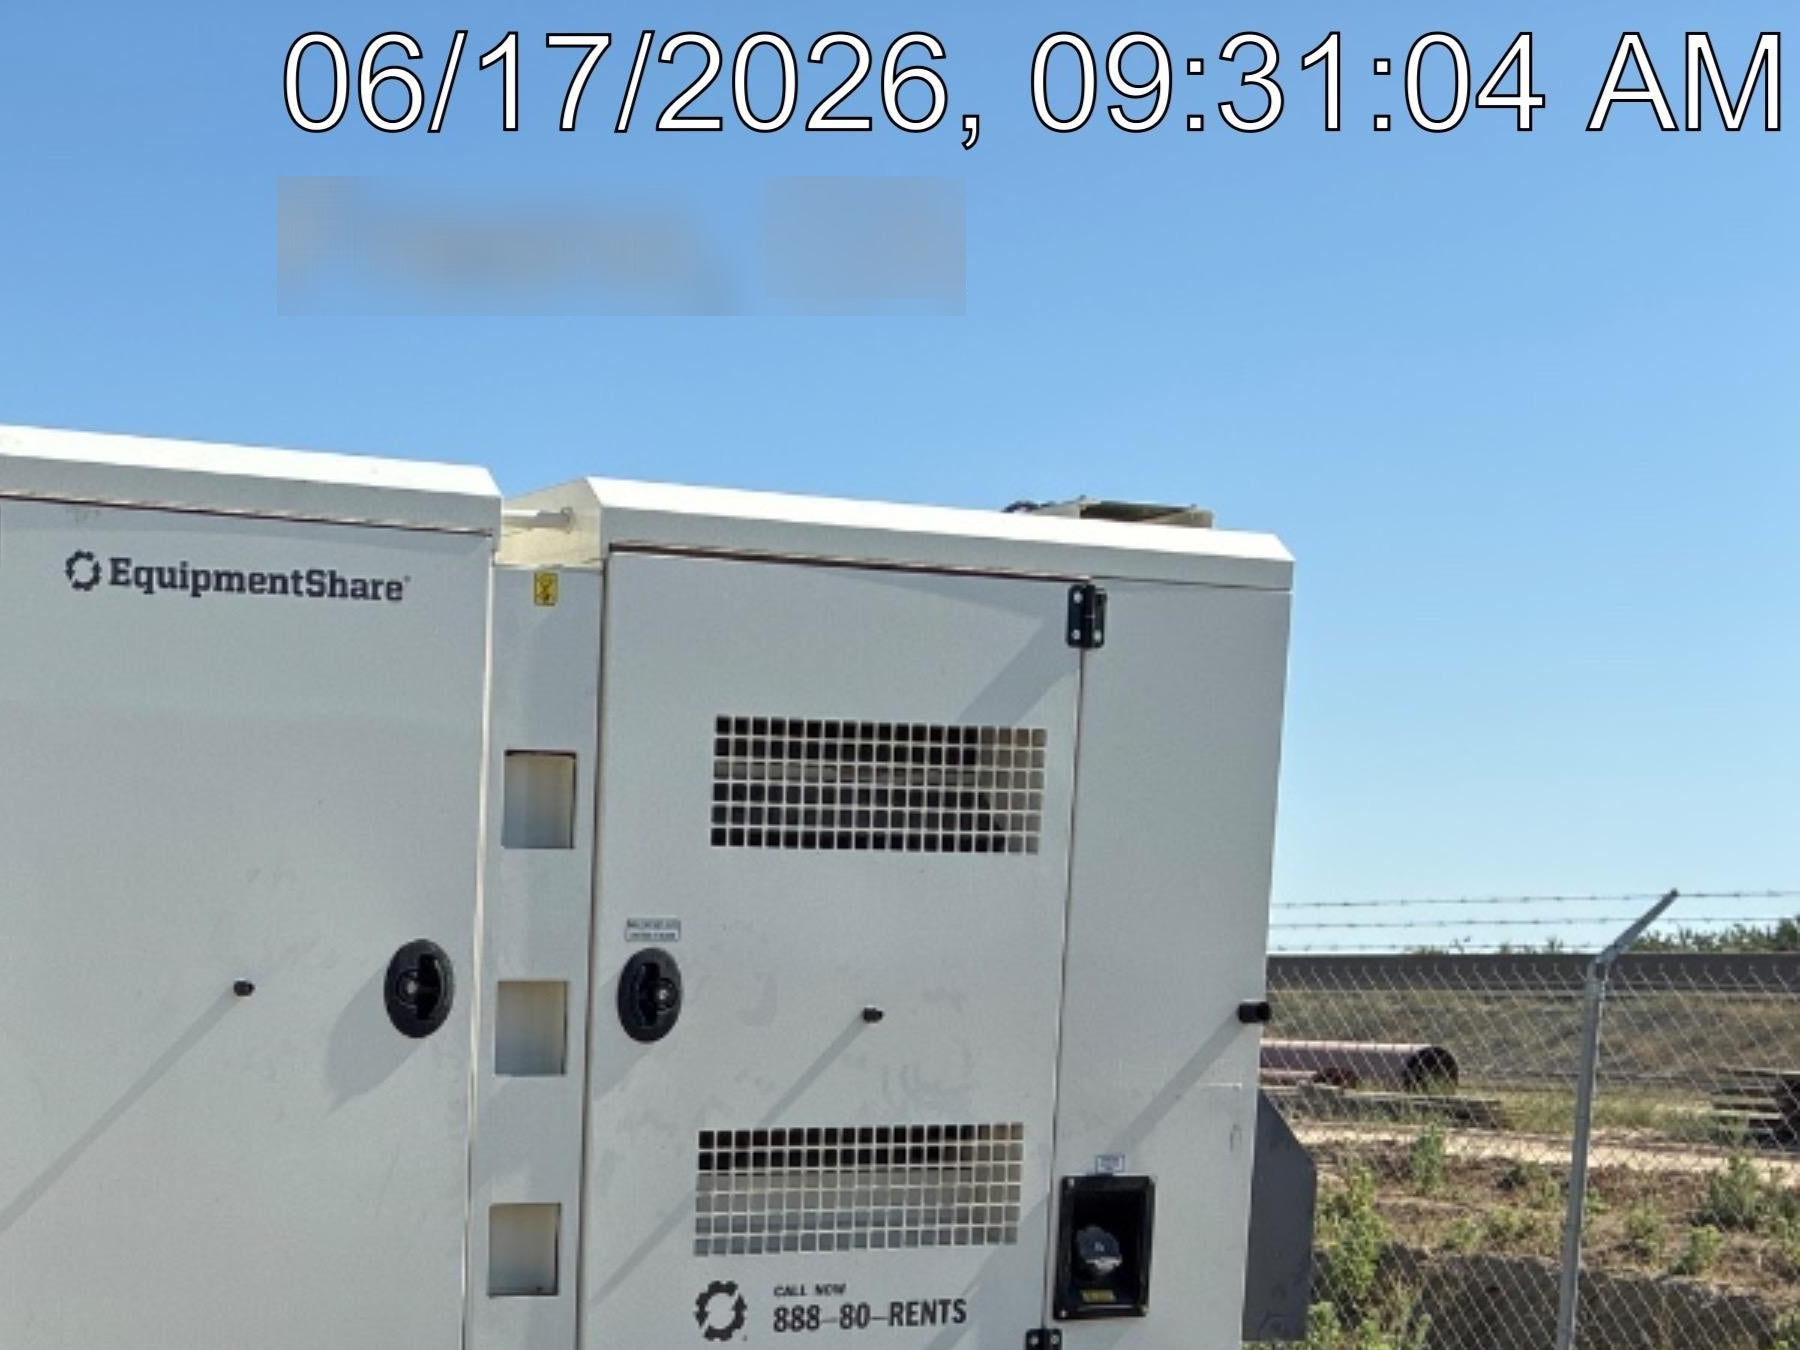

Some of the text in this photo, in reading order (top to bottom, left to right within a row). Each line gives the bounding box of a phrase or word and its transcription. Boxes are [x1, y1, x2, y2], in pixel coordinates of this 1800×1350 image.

[108, 556, 404, 601] EquipmentShare
[773, 1282, 848, 1297] CALL NOW
[772, 1298, 968, 1333] 888-80-RENTS
